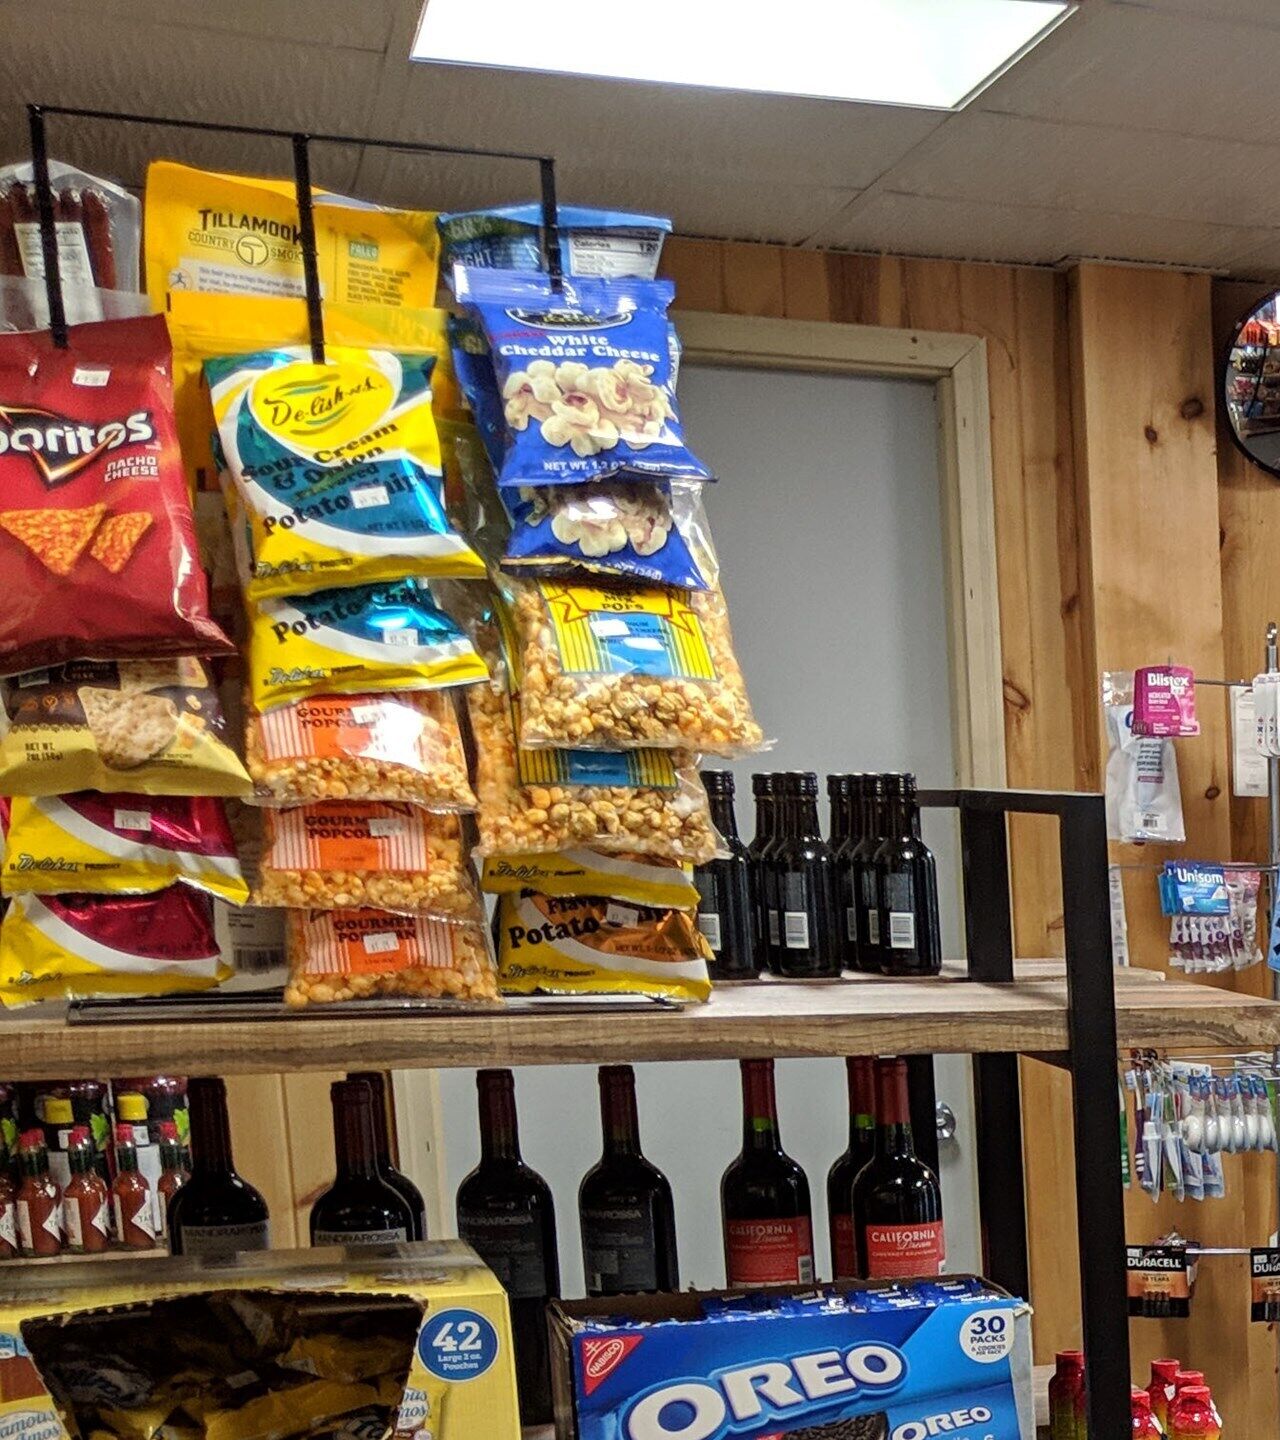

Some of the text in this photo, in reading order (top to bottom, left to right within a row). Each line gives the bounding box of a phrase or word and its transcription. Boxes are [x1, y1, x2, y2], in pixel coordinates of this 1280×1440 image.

[188, 231, 236, 249] COUNTRY
[574, 240, 611, 249] Calories
[547, 334, 608, 346] White
[500, 346, 661, 362] Cheddar Cheese
[242, 423, 398, 482] Sour Cream
[107, 456, 156, 472] NACHO
[304, 446, 385, 482] Onion
[543, 461, 567, 471] NET
[104, 467, 159, 483] CHEESE
[263, 494, 352, 537] Potato
[270, 601, 365, 643] Potato
[1148, 672, 1188, 687] Blistex
[1177, 867, 1224, 884] Unisom
[333, 917, 416, 930] GOURMET
[508, 917, 601, 949] Potato
[729, 1224, 793, 1237] CALIFORNIA
[871, 1230, 937, 1244] CALIFORNIA
[1127, 1257, 1182, 1269] DURACELL
[969, 1315, 1006, 1335] 30
[432, 1320, 483, 1352] 42
[970, 1334, 1006, 1344] PACKS
[438, 1353, 469, 1363] Large 2
[589, 1338, 624, 1378] NABISCO
[443, 1362, 479, 1371] Pouches
